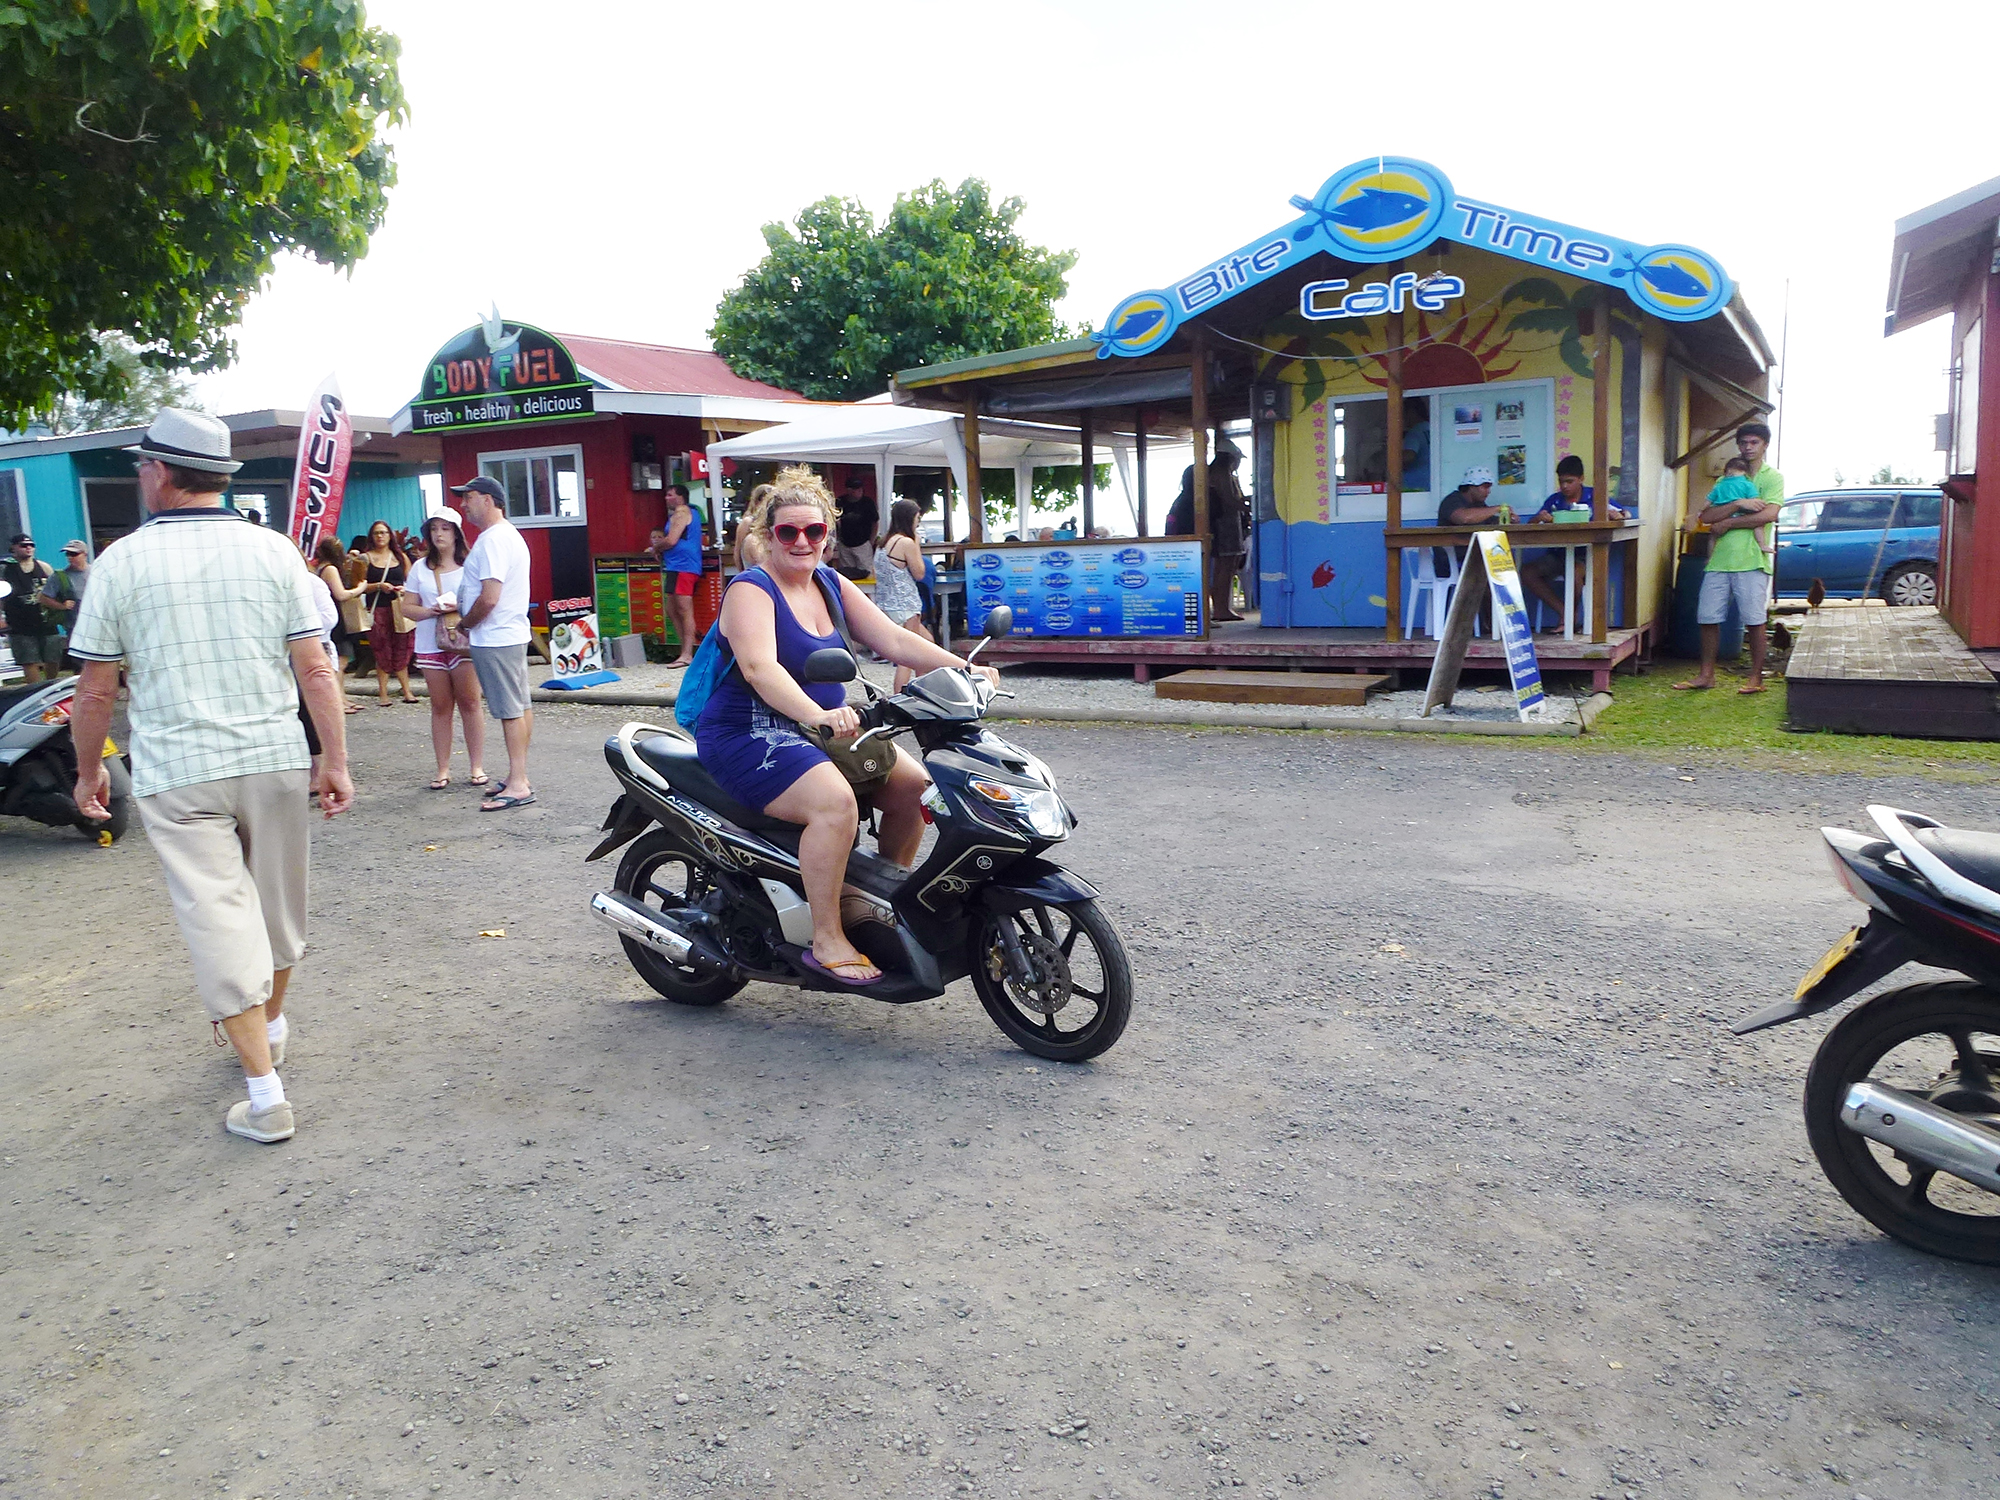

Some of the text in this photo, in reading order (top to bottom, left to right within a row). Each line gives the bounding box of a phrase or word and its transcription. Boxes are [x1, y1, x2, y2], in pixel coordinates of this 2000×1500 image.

[1177, 201, 1613, 313] Bite Time
[1301, 272, 1464, 320] Cafe
[432, 348, 561, 396] BODY FUEL
[423, 396, 583, 426] fresh healthy delicious
[302, 393, 343, 561] SUSH
[666, 795, 722, 829] NOUVO
